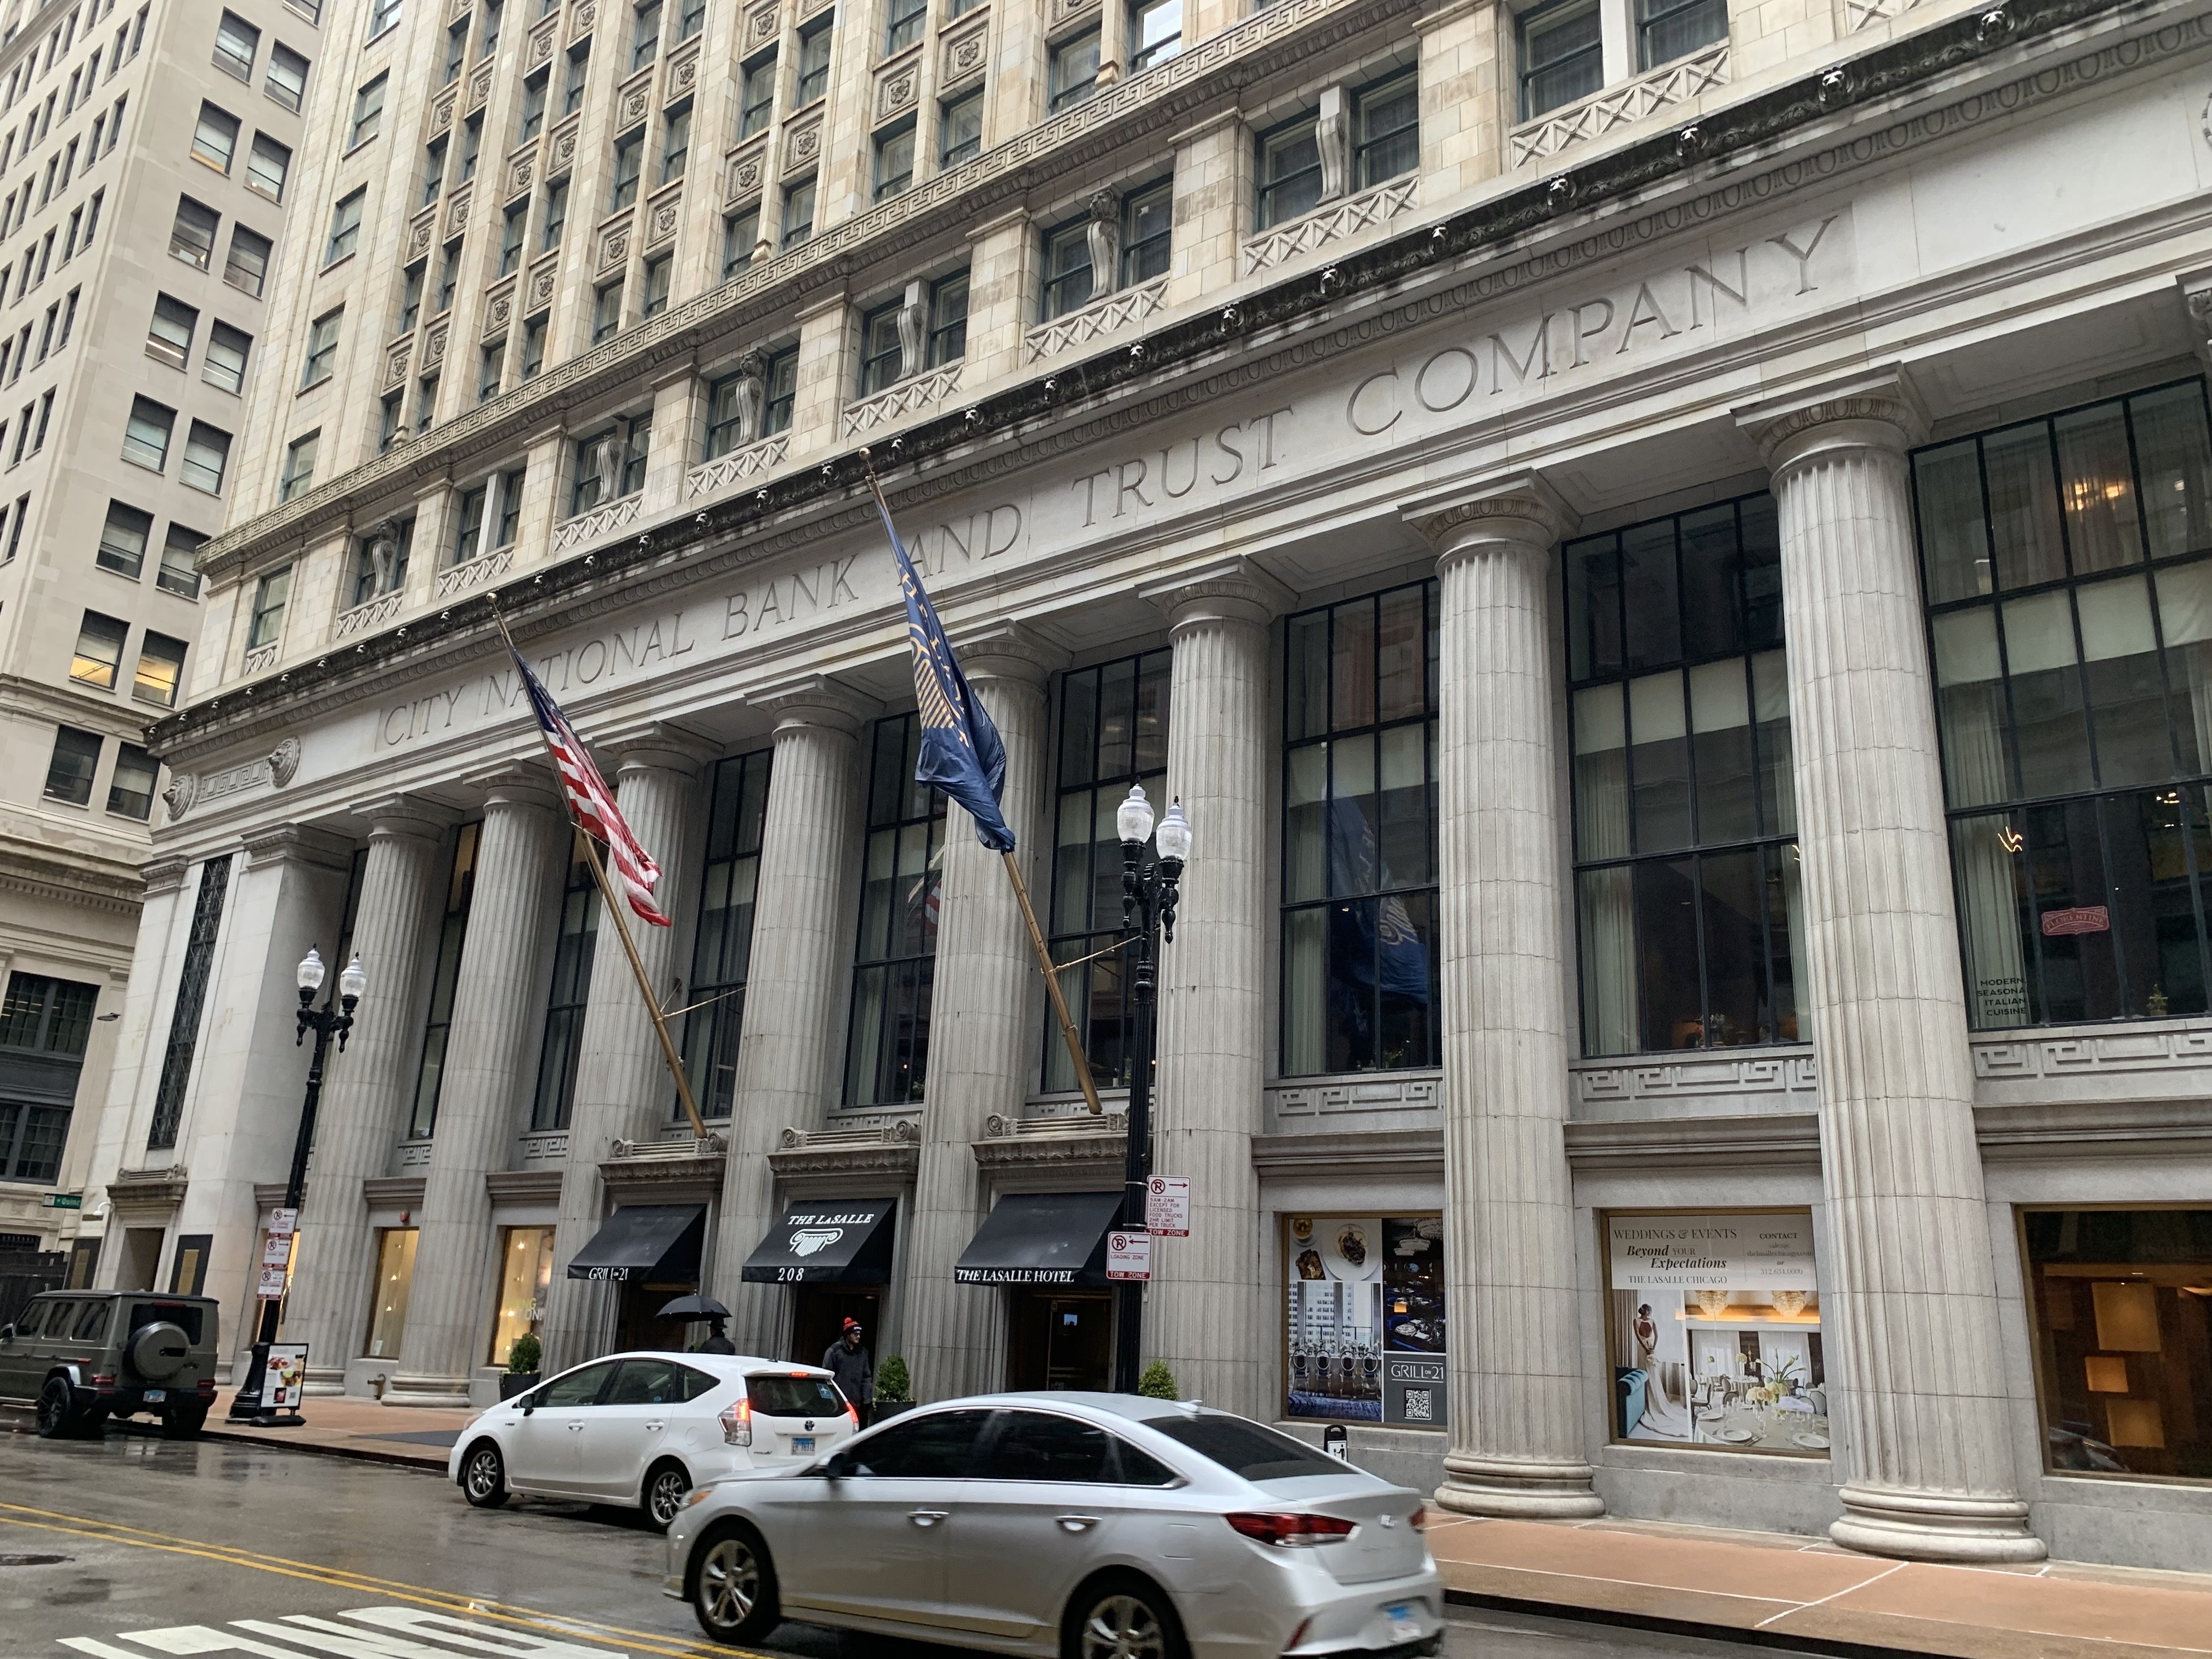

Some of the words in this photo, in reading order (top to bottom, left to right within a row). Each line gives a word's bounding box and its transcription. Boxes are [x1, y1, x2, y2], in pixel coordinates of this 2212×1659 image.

[383, 685, 464, 746] CITY
[721, 554, 859, 641] BANK
[1071, 405, 1295, 528] TRUST
[1347, 215, 1838, 436] COMPANY
[1980, 977, 2024, 987] MODERN
[1976, 988, 2026, 997] SEASONA
[1985, 997, 2026, 1006] ITALIAN
[1986, 1007, 2027, 1016] CUISINE
[788, 1215, 816, 1225] THE
[1613, 1229, 1675, 1240] WEDDINGS
[1678, 1229, 1689, 1239] &
[1692, 1228, 1737, 1239] EVENTS
[1627, 1244, 1669, 1259] Beyond
[1672, 1247, 1696, 1256] YOUR
[1650, 1257, 1728, 1271] Expectations
[777, 1267, 804, 1282] 208
[957, 1269, 981, 1280] THE
[982, 1269, 1032, 1282] LASALLE
[1034, 1270, 1075, 1283] HOTEL
[1628, 1276, 1646, 1284] THE
[1648, 1276, 1685, 1284] LASALLE
[1686, 1276, 1728, 1284] CHICAGO
[1391, 1364, 1429, 1379] GRILL
[1431, 1366, 1444, 1379] 21
